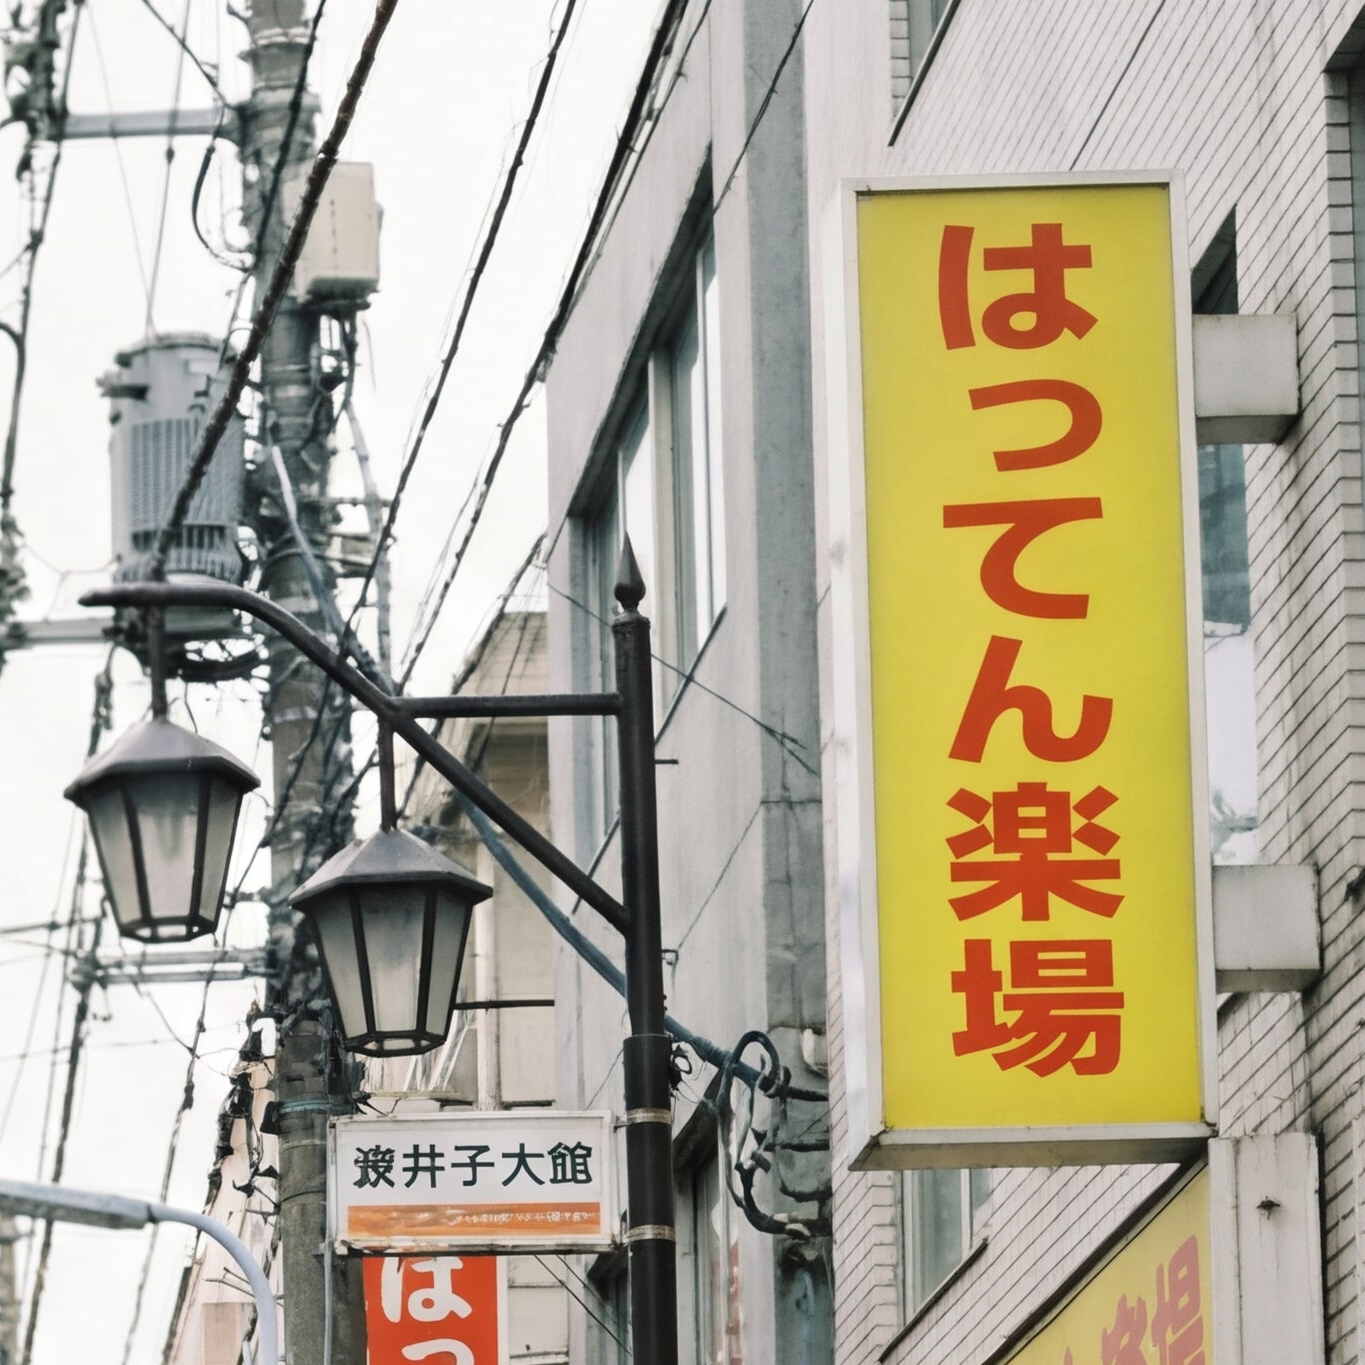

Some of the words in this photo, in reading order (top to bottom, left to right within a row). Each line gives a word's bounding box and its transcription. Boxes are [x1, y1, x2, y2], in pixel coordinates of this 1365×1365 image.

[937, 222, 1126, 1078] はってん楽場
